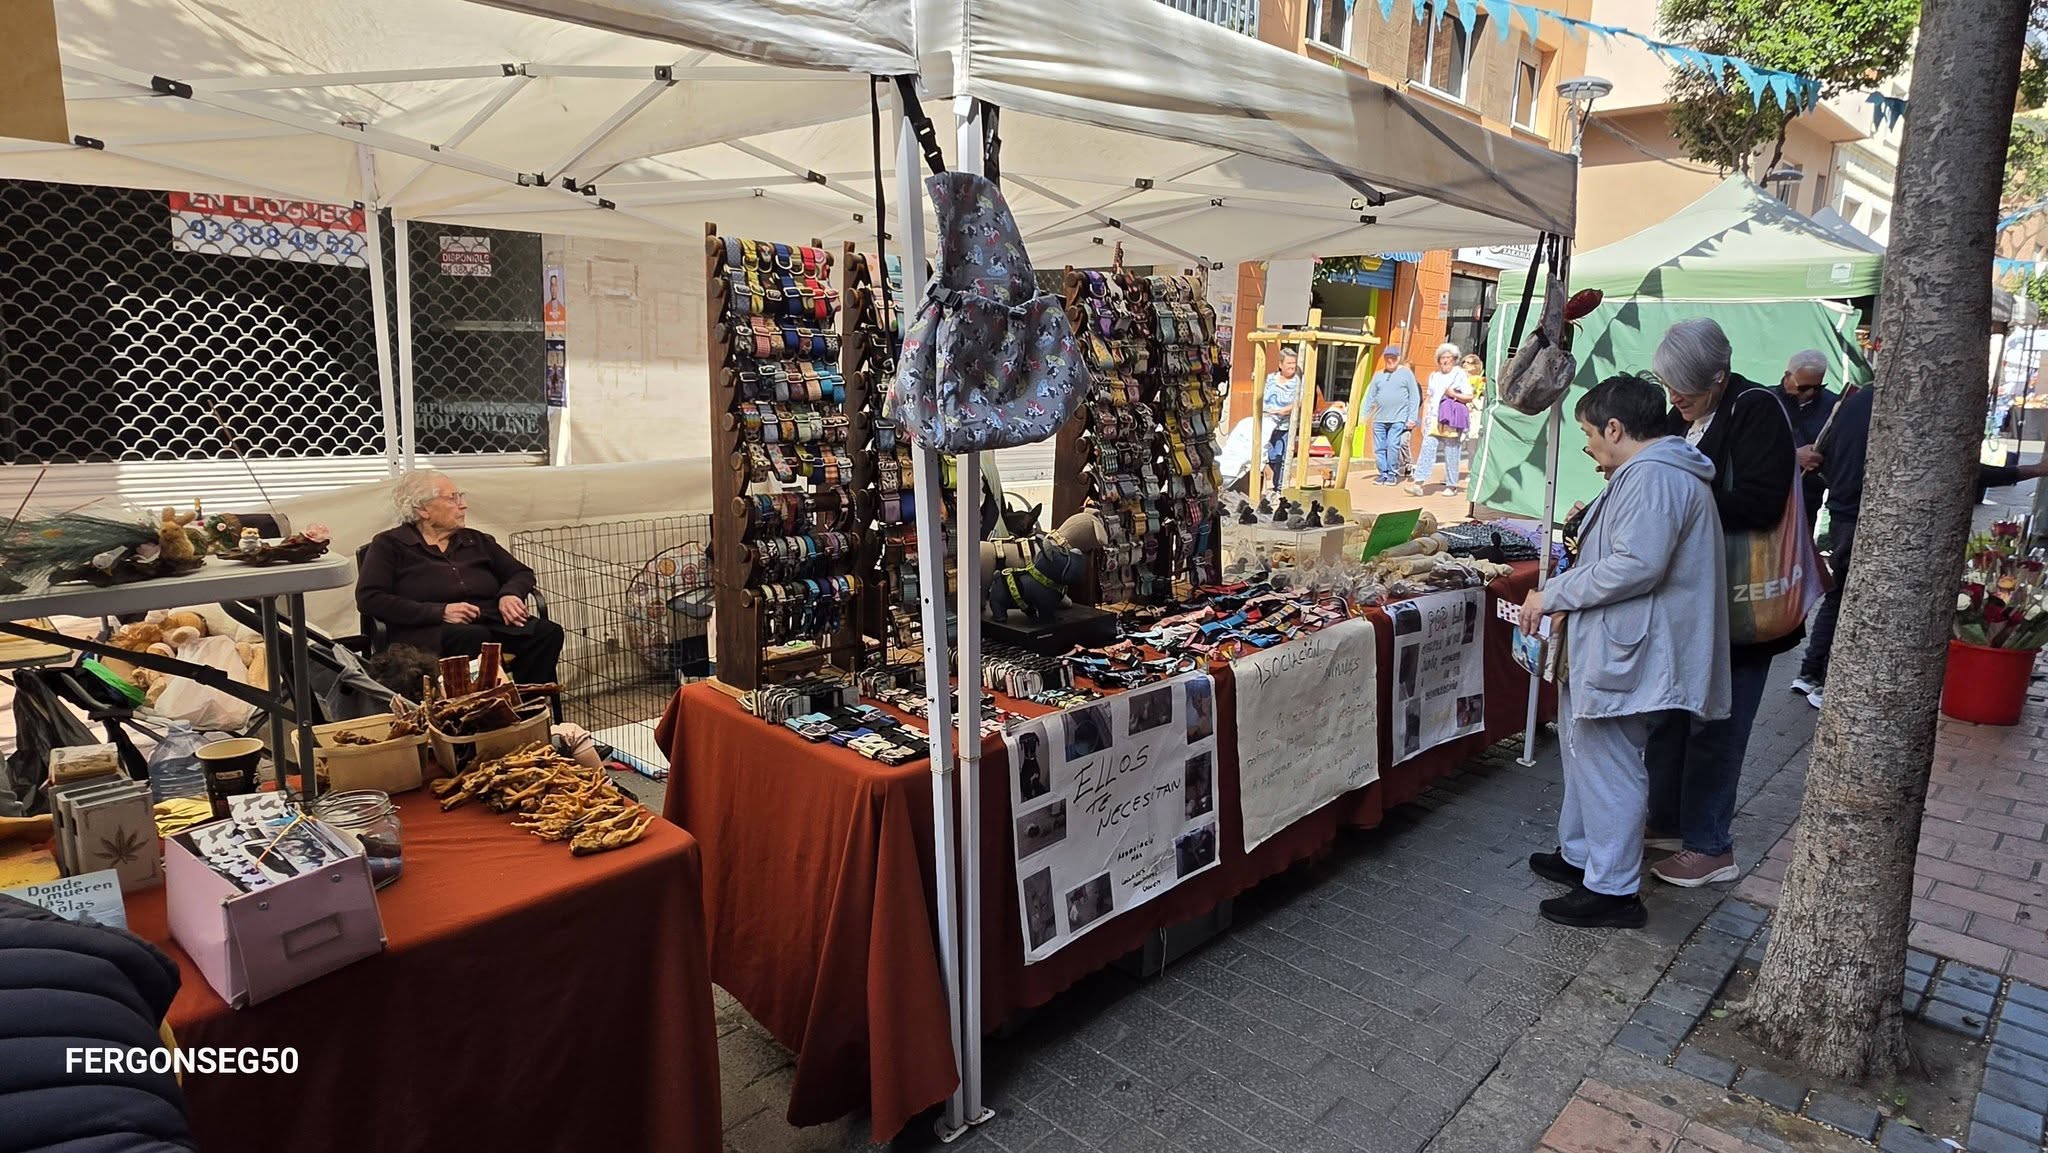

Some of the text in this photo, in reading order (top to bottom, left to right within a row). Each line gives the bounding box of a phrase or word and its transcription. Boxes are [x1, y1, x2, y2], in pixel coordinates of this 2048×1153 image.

[188, 192, 352, 226] EN LLOGUER
[190, 219, 354, 256] 93 388 49 52
[442, 252, 490, 264] DISPONIBLE
[461, 411, 540, 435] ONLINE
[1073, 744, 1150, 804] ELLOS
[1085, 792, 1112, 815] TE
[1096, 777, 1181, 837] NECESITAN
[27, 879, 82, 897] Donde
[47, 881, 113, 901] mueren
[58, 899, 95, 913] olas
